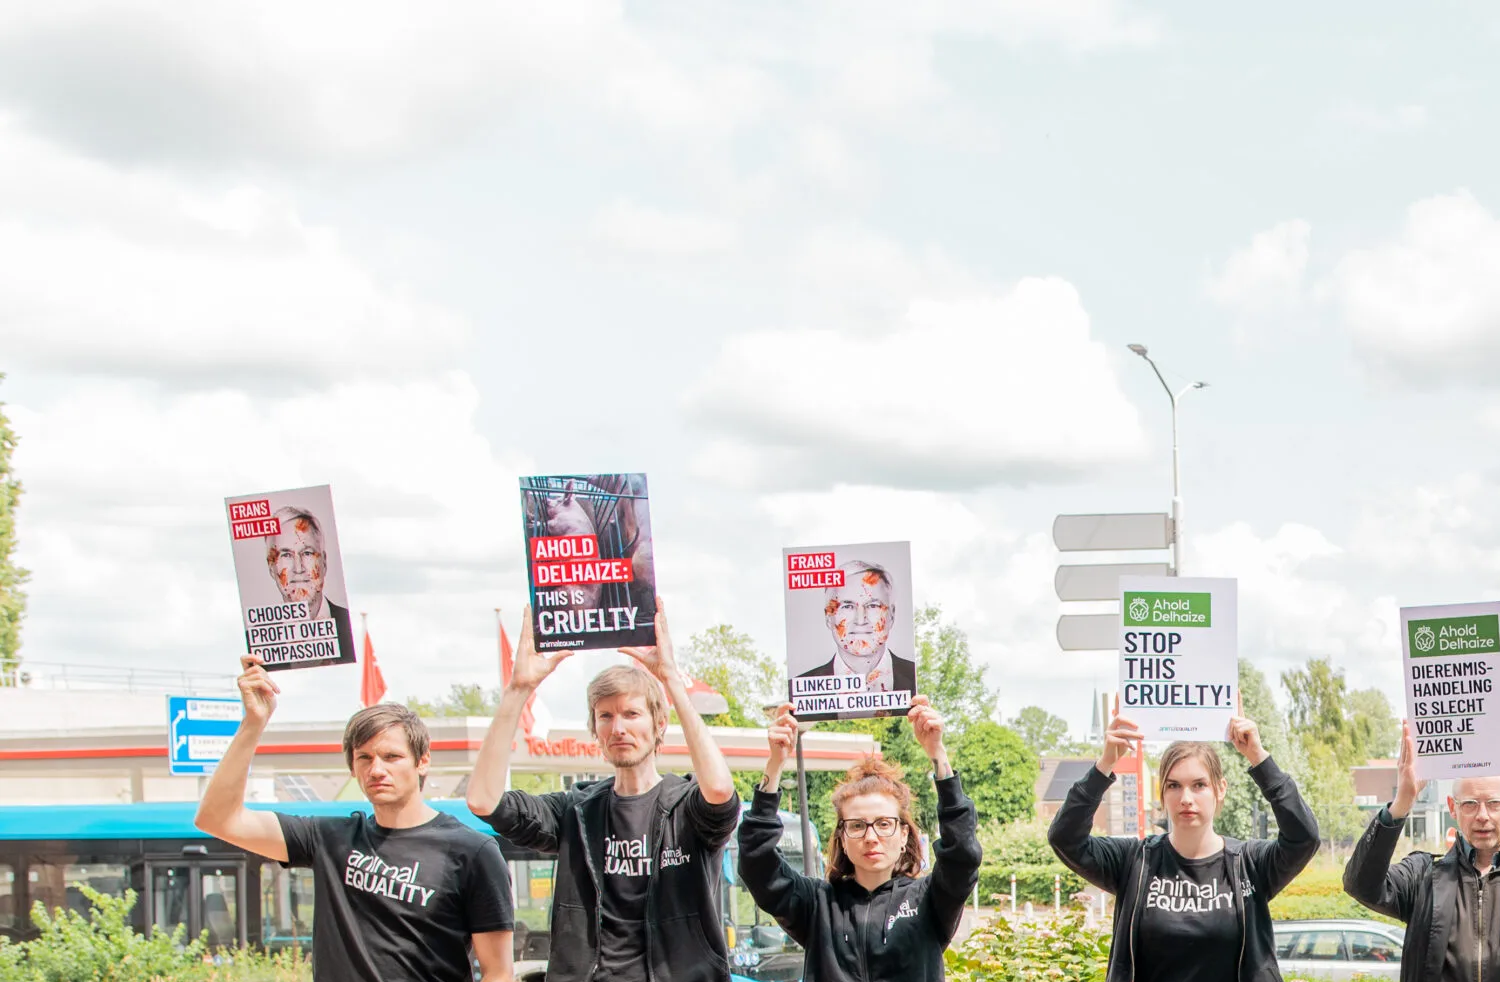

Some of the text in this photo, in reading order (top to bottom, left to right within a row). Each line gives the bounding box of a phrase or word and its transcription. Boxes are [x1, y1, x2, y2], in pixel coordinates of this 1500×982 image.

[232, 502, 267, 518] FRANS
[235, 520, 278, 537] MULLER
[536, 538, 593, 558] AHOLD
[791, 555, 832, 569] FRANS
[538, 562, 628, 583] DELHAIZE:
[791, 573, 841, 587] MULLER
[536, 590, 584, 606] THIS IS
[1153, 599, 1189, 610] Ahold
[248, 603, 306, 623] CHOOSES
[539, 607, 638, 635] CRUELTY
[1153, 611, 1205, 622] Delhaize
[252, 621, 334, 643] PROFIT OVER
[1439, 624, 1476, 637] Ahold
[1125, 632, 1182, 653] STOP
[1440, 637, 1494, 650] Delhaize
[1125, 658, 1175, 679] THIS
[1412, 661, 1493, 679] DIERENMIS-
[796, 677, 861, 692] LINKED TO
[1413, 679, 1492, 697] HANDELING
[797, 694, 907, 712] ANIMAL CRUELTY!
[1125, 684, 1231, 705] CRUELTY!
[1415, 698, 1484, 716] IS SLECHT
[1416, 718, 1474, 735] VOOR JE
[1417, 738, 1462, 754] ZAKEN
[604, 834, 647, 858] nimal
[347, 849, 420, 884] animal
[604, 856, 653, 876] UALIT
[344, 866, 436, 907] EQUALITY
[1150, 875, 1217, 898] animal
[1147, 891, 1233, 912] EQUALITY
